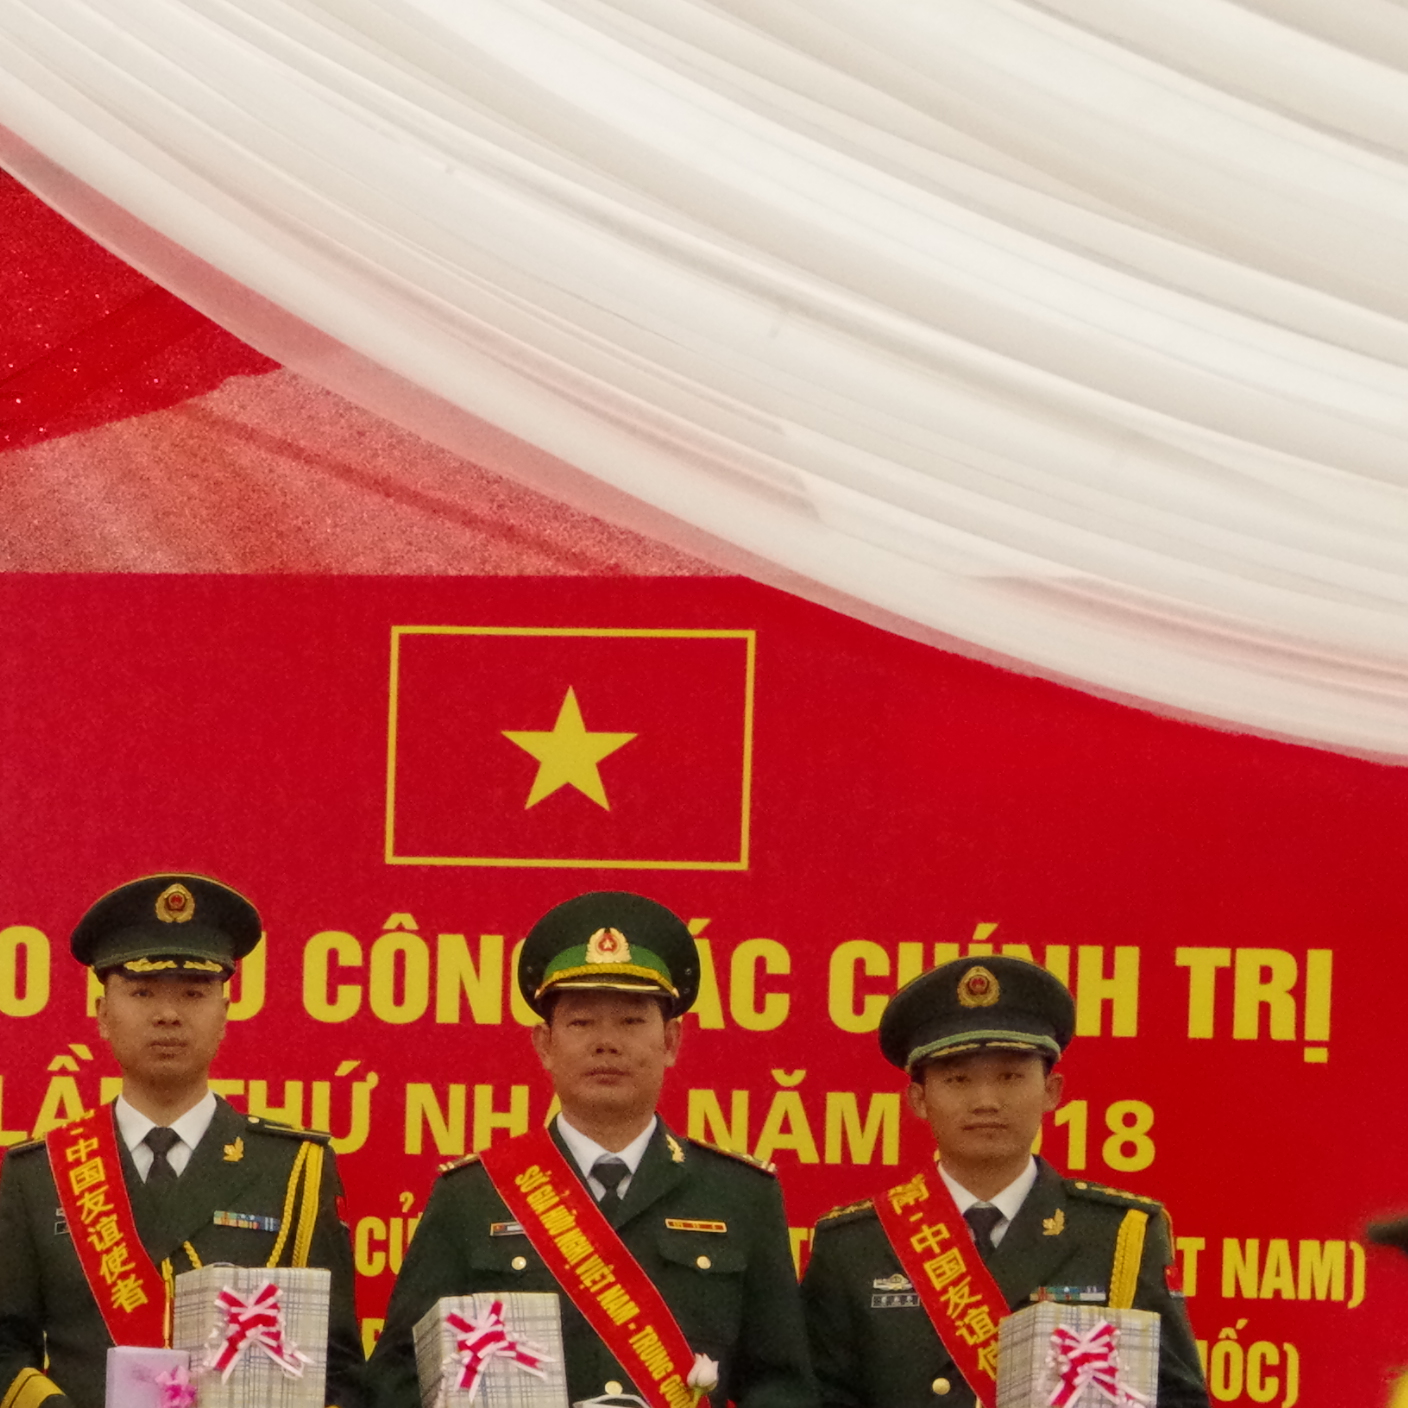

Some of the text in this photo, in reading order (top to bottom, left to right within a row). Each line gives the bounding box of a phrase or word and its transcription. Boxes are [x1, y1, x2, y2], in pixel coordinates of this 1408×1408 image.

[683, 918, 791, 1031] ÁC
[1177, 947, 1333, 1063] TRỊ
[687, 1069, 900, 1166] NĂM
[575, 1254, 616, 1293] VIỆT
[596, 1283, 640, 1326] NAM
[629, 1325, 674, 1381] TRUNG
[1222, 1238, 1365, 1309] NAM)
